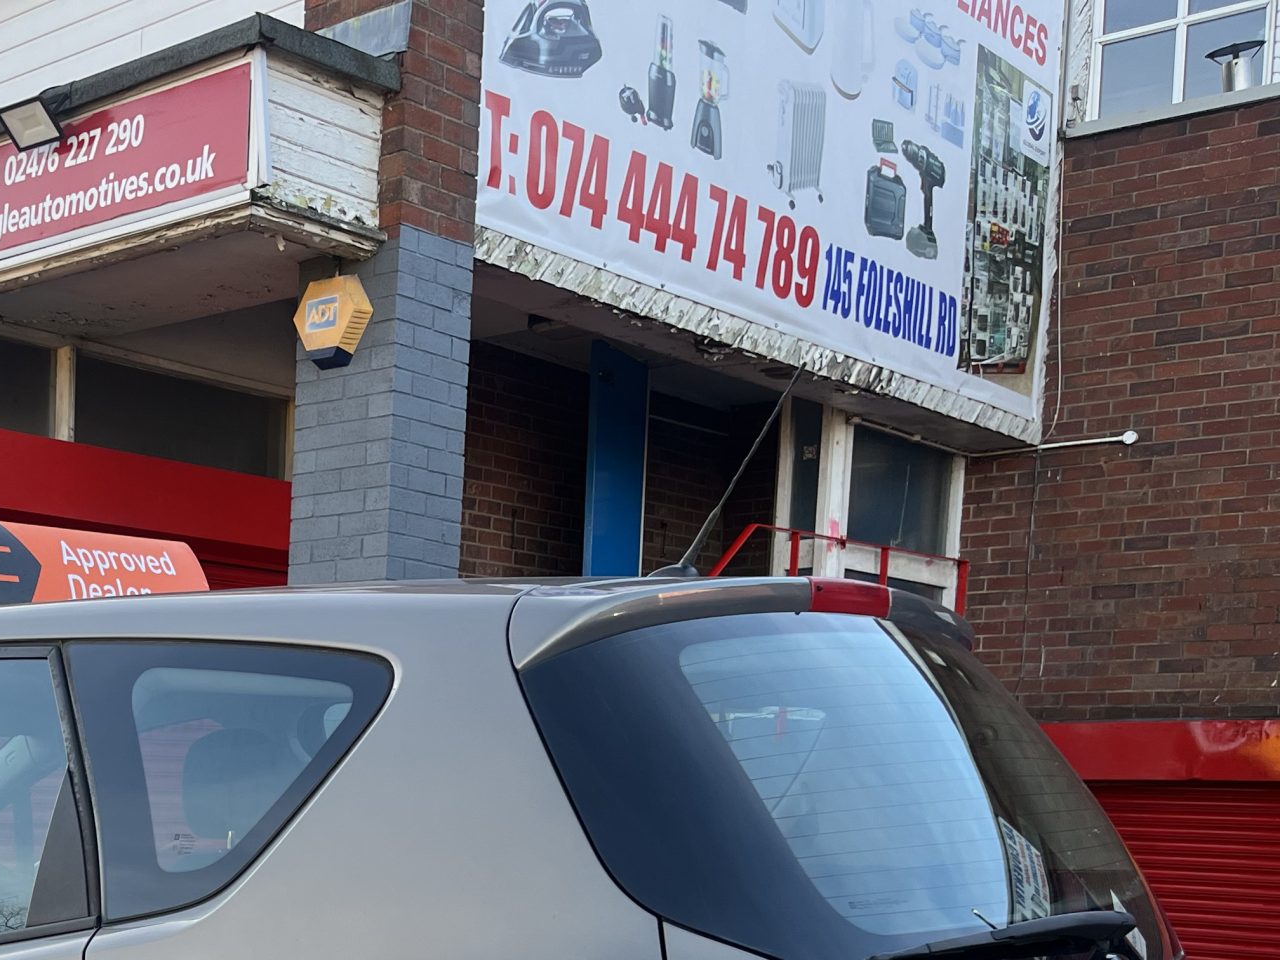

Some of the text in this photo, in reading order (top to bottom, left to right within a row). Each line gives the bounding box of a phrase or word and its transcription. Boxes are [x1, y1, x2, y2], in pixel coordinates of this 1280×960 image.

[3, 140, 60, 186] 02476
[64, 127, 101, 168] 227
[105, 114, 145, 156] 290
[525, 110, 609, 230] 074
[617, 150, 698, 263] 444
[706, 184, 748, 281] 74
[755, 205, 820, 308] 789
[308, 303, 338, 324] ADT
[822, 243, 957, 357] 145 FOLESHILL RD
[60, 540, 176, 576] Approved
